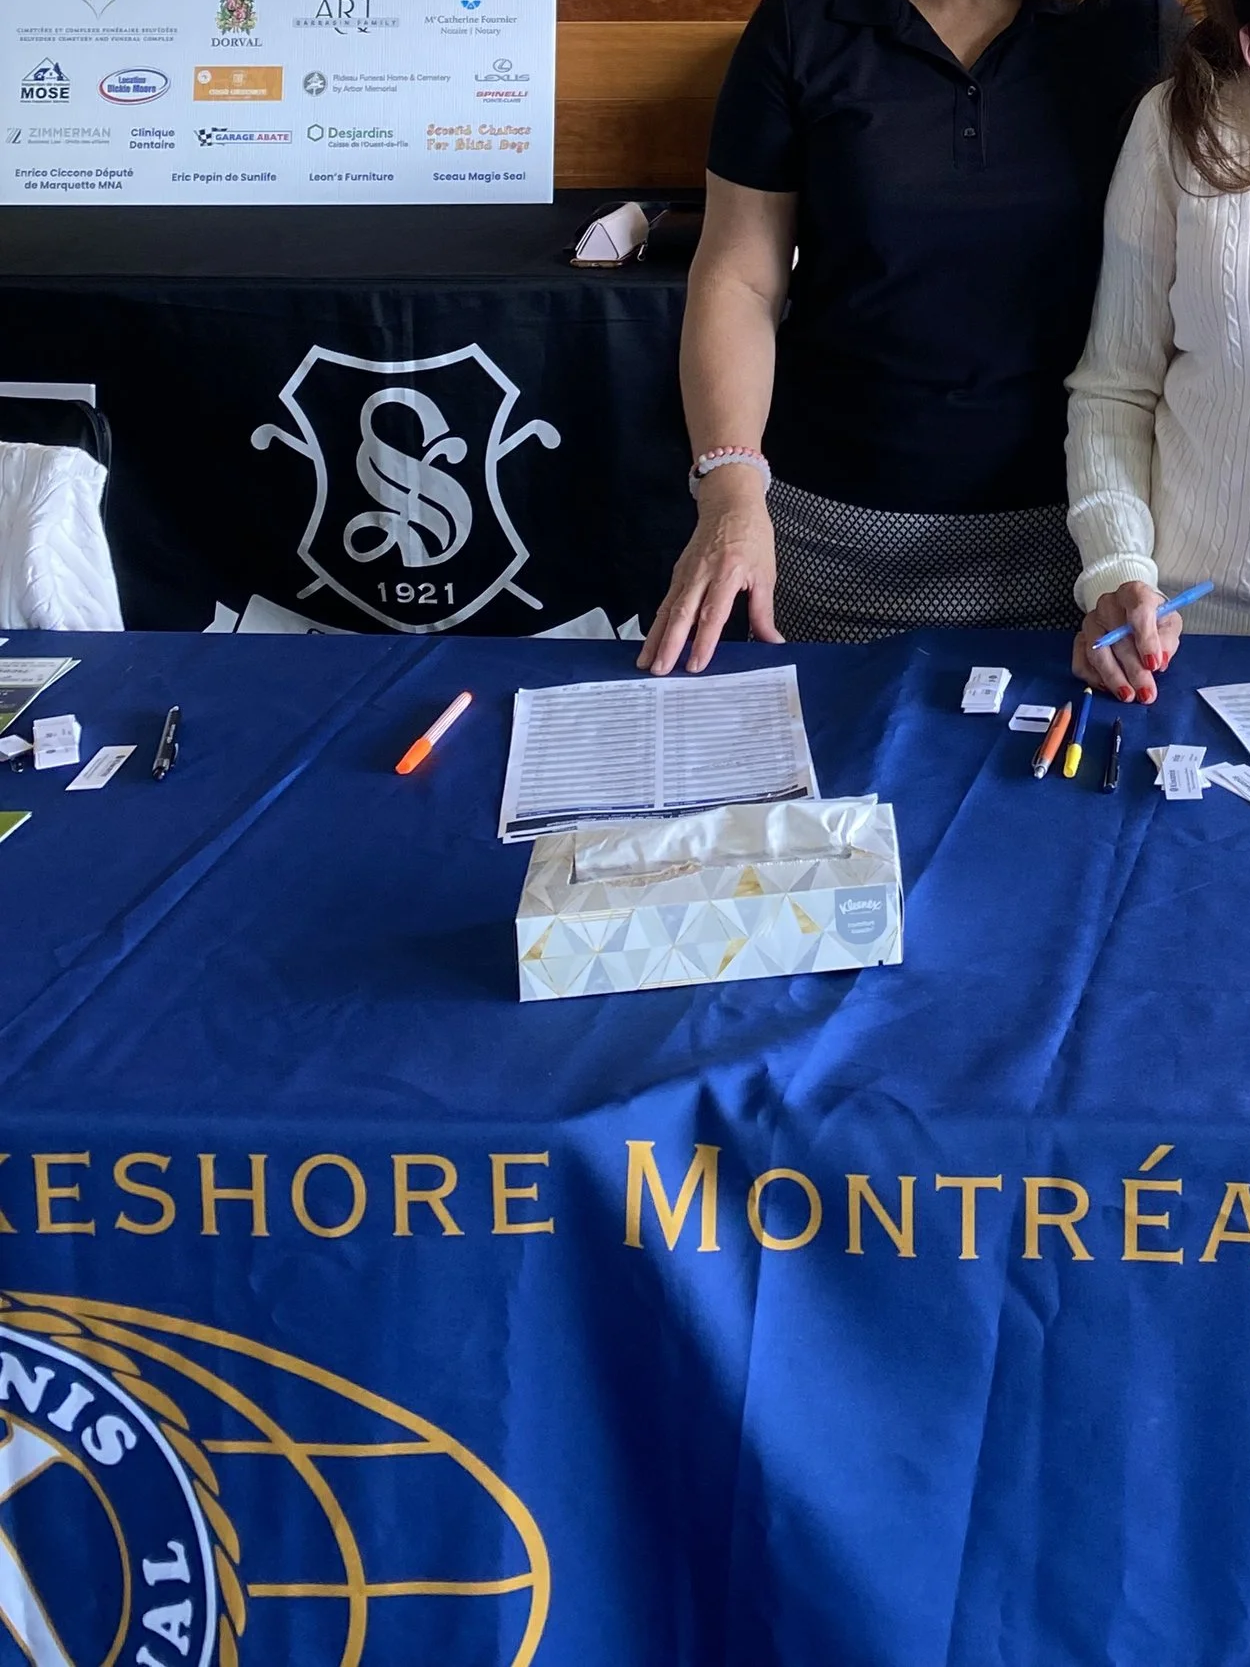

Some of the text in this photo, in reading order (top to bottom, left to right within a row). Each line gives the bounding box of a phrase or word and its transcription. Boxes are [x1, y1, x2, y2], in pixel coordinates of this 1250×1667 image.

[437, 16, 479, 24] Catherine
[481, 15, 517, 23] Fournier
[212, 38, 262, 47] DORVAL
[475, 74, 530, 82] LEXUS
[20, 87, 70, 98] MOSE
[28, 128, 110, 138] ZIMMERMAN
[131, 128, 175, 139] Clinique
[328, 127, 393, 141] Desjardins
[130, 140, 175, 149] Dentaire
[15, 168, 134, 180] Enrico Ciccone Député
[172, 172, 276, 184] Eric Pepin de Sunlife
[345, 172, 394, 181] Furniture
[503, 172, 525, 180] Seal
[24, 181, 122, 192] de Marquette MNA
[378, 582, 454, 604] 1921
